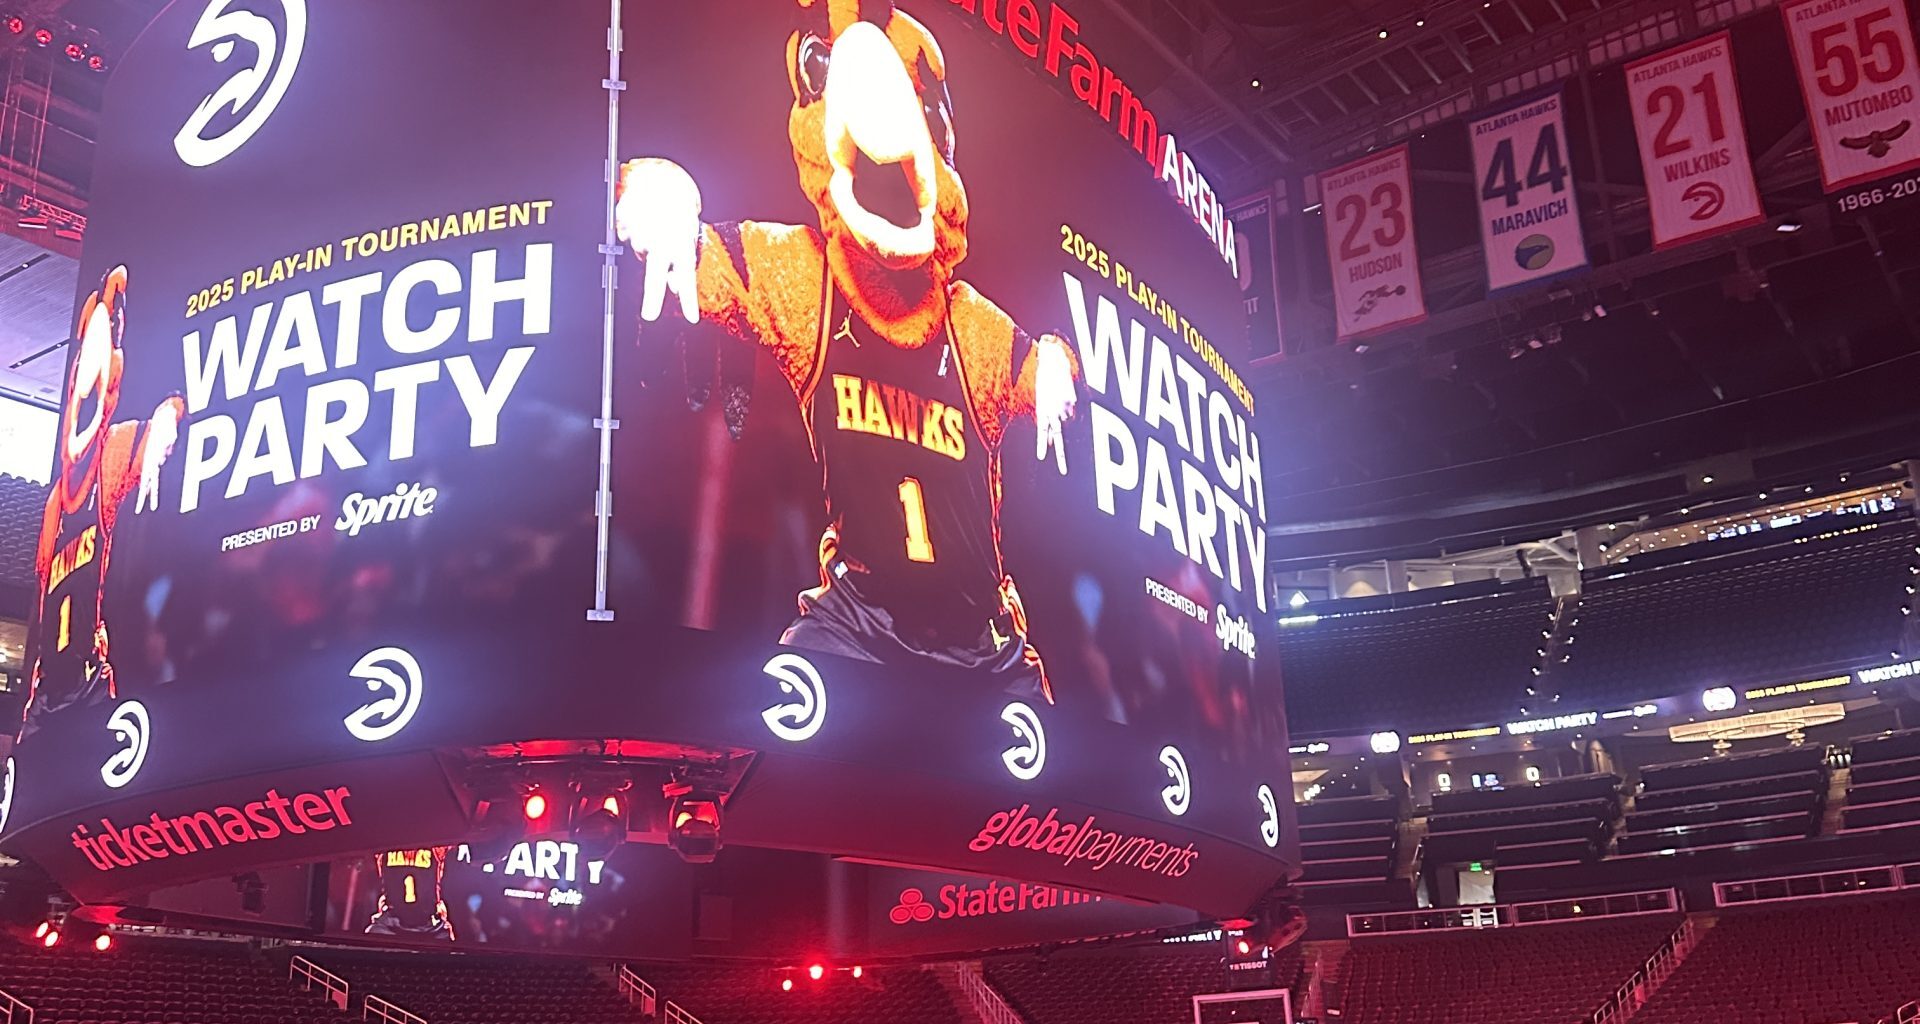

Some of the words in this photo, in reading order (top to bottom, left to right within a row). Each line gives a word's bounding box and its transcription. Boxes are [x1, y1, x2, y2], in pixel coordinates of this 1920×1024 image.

[1633, 59, 1681, 84] ATLANTA
[1682, 46, 1722, 68] HAWKS
[1810, 7, 1904, 97] 55
[1476, 113, 1519, 136] ATLANTA
[1520, 99, 1557, 121] HAWKS
[1647, 71, 1725, 159] 21
[1824, 85, 1913, 126] MUTOMBO
[1327, 170, 1367, 192] ATLANTA
[1368, 158, 1401, 179] HAWKS
[1482, 122, 1567, 208] 44
[1664, 148, 1730, 182] WILKINS
[1156, 133, 1238, 279] ARENA
[1335, 181, 1406, 262] 23
[1492, 198, 1568, 236] MARAVICH
[185, 278, 235, 319] 2025
[240, 244, 333, 295] PLAY-IN
[341, 200, 553, 262] TOURNAMENT
[1349, 253, 1403, 283] HUDSON
[182, 243, 553, 415] WATCH
[1060, 224, 1110, 279] 2025
[1115, 261, 1178, 334] PLAY-IN
[1180, 316, 1255, 417] TOURNAMENT
[179, 346, 536, 513] PARTY
[832, 373, 966, 461] HAWKS
[1062, 271, 1267, 524] WATCH
[221, 520, 298, 552] PRESENTED
[299, 514, 321, 533] BY
[334, 482, 438, 537] Sprite
[898, 476, 935, 563] 1
[1090, 401, 1267, 614] PARTY
[47, 524, 97, 595] HAWKS
[57, 595, 71, 652] 1
[1145, 577, 1197, 618] PRESENTED
[1196, 604, 1209, 624] BY
[1215, 603, 1256, 660] Sprite
[1857, 662, 1912, 684] WATCH
[1506, 718, 1554, 736] WATCH
[1554, 711, 1598, 729] PARTY
[71, 786, 352, 871] ticketmaster
[386, 849, 432, 869] HAWKS
[483, 840, 605, 885] ARTY
[968, 803, 1198, 878] globalpayments
[404, 875, 417, 903] 1
[1239, 960, 1267, 971] TISSOT
